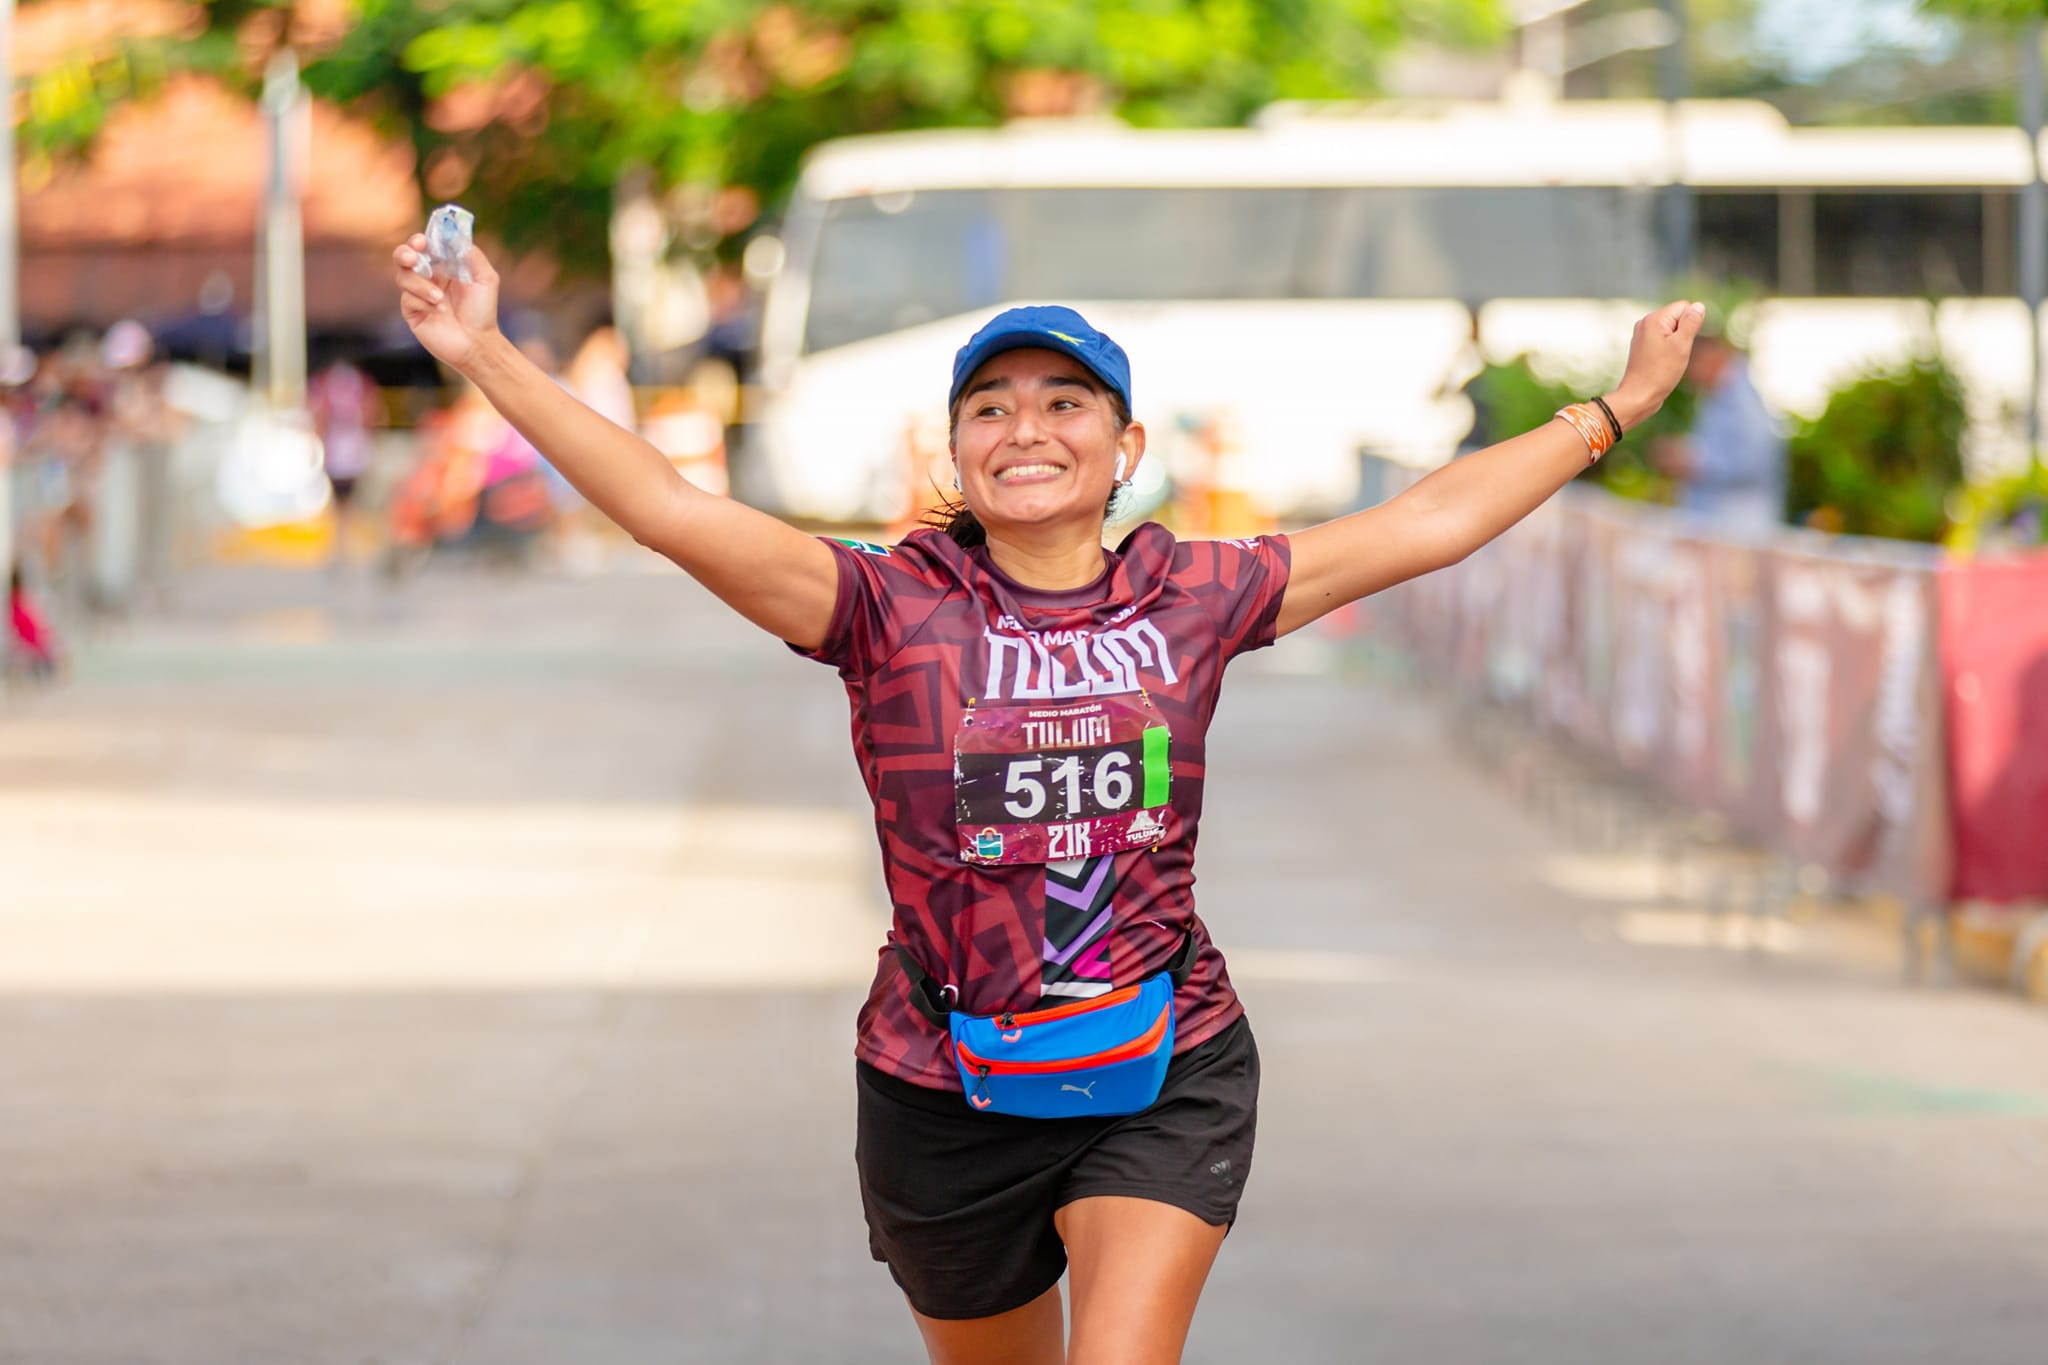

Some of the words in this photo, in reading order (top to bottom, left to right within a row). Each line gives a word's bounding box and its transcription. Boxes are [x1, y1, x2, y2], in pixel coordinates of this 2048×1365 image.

[983, 618, 1179, 699] TULUM
[1028, 711, 1059, 719] MEDIO
[1060, 703, 1103, 717] MARATÓN
[1021, 714, 1112, 750] TULUM
[1004, 751, 1133, 818] 516
[1047, 822, 1092, 859] 21K
